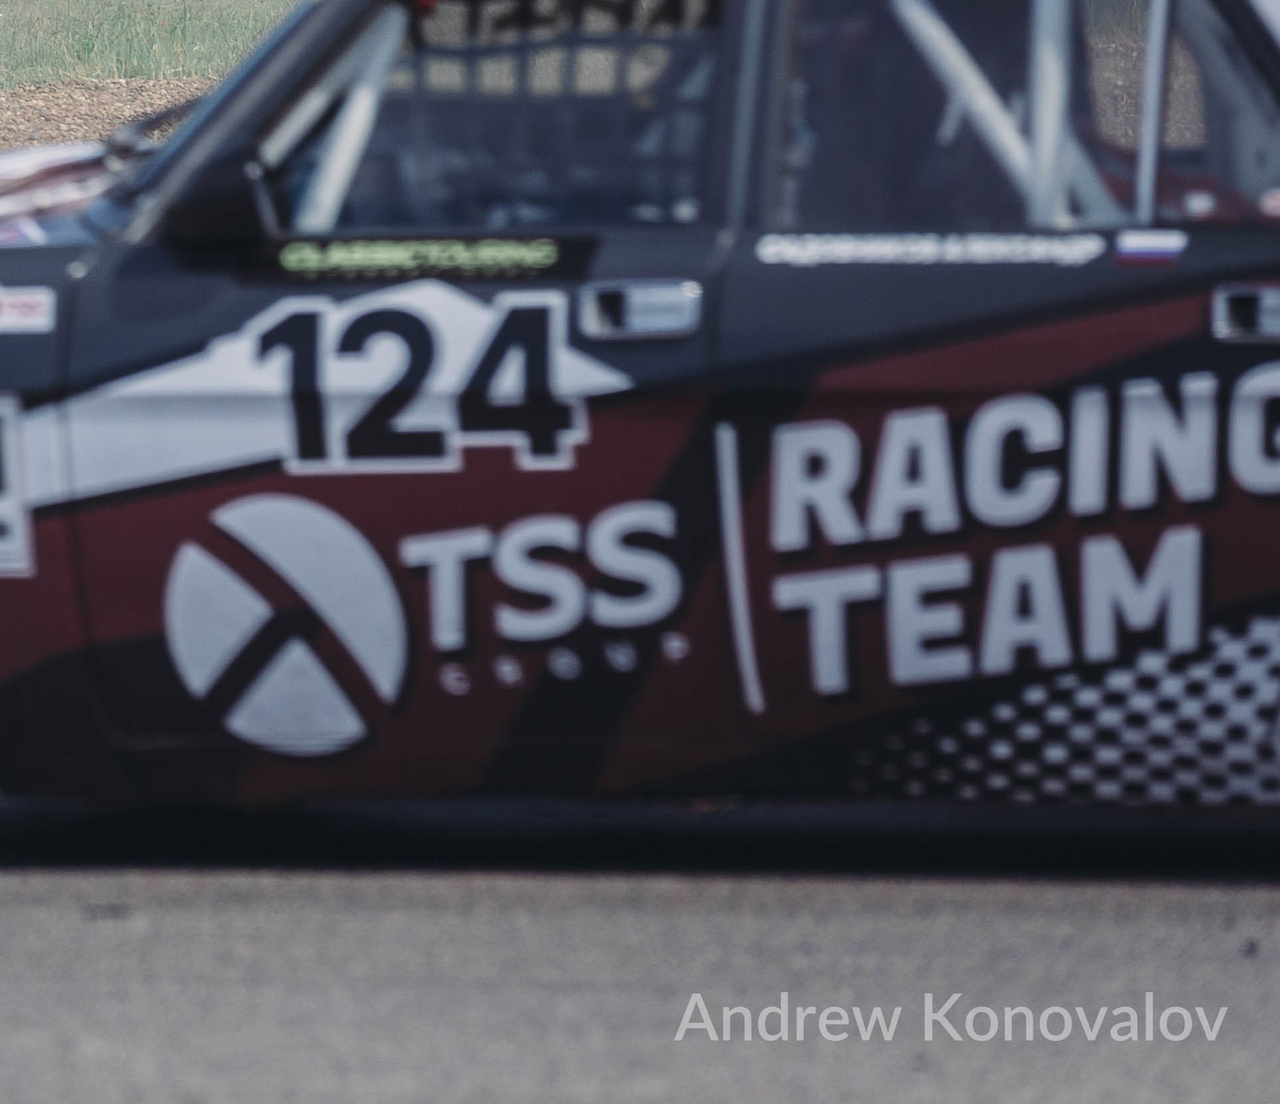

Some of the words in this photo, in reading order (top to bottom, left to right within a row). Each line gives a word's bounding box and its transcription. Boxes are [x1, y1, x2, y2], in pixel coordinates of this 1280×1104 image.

[258, 305, 575, 461] 124
[400, 499, 684, 653] TSS
[770, 523, 1204, 695] TEAM
